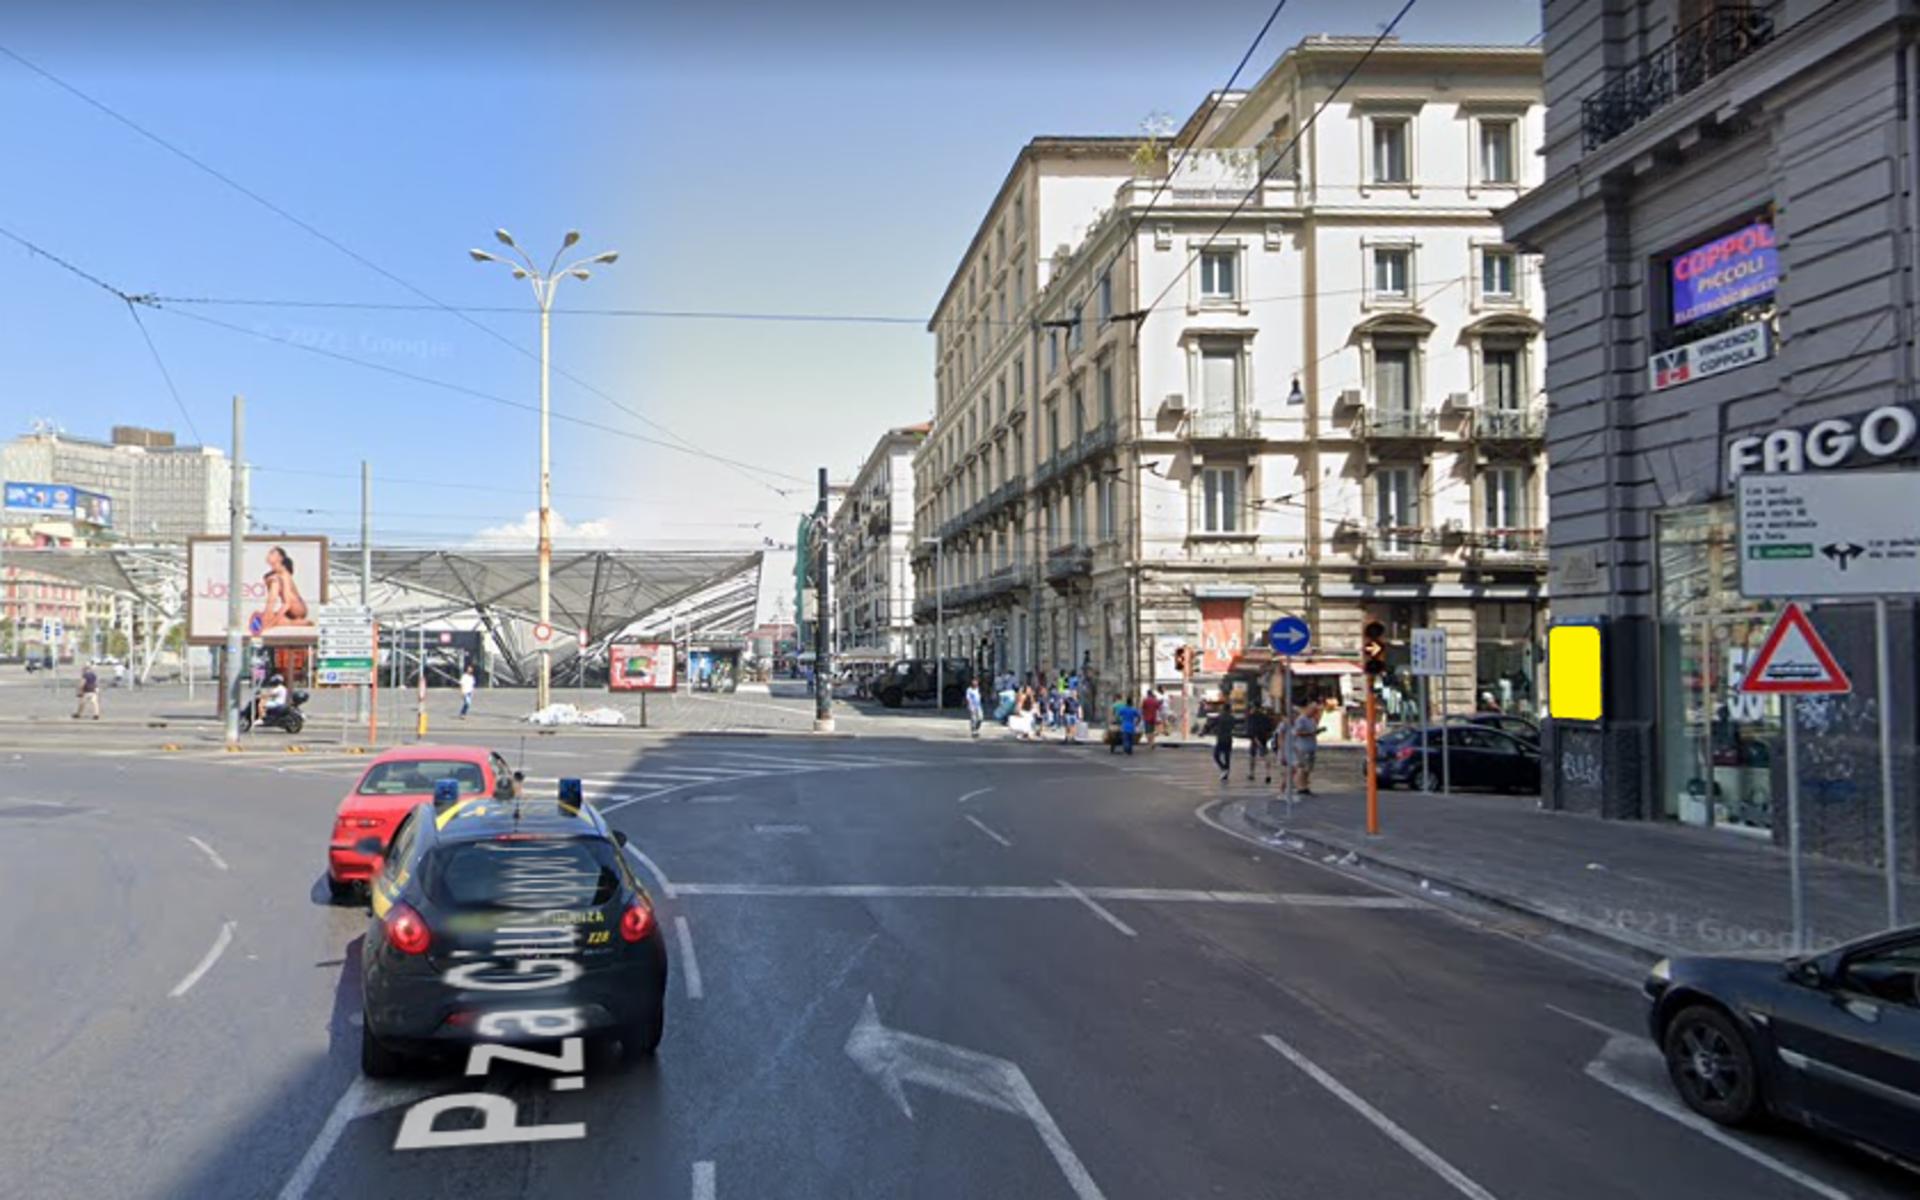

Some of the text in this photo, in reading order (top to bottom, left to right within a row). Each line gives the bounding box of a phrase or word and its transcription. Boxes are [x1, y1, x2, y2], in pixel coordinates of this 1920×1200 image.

[1697, 255, 1764, 293] PICCOLI
[1698, 328, 1759, 356] VINCENZO
[1699, 347, 1757, 374] COPPOLA
